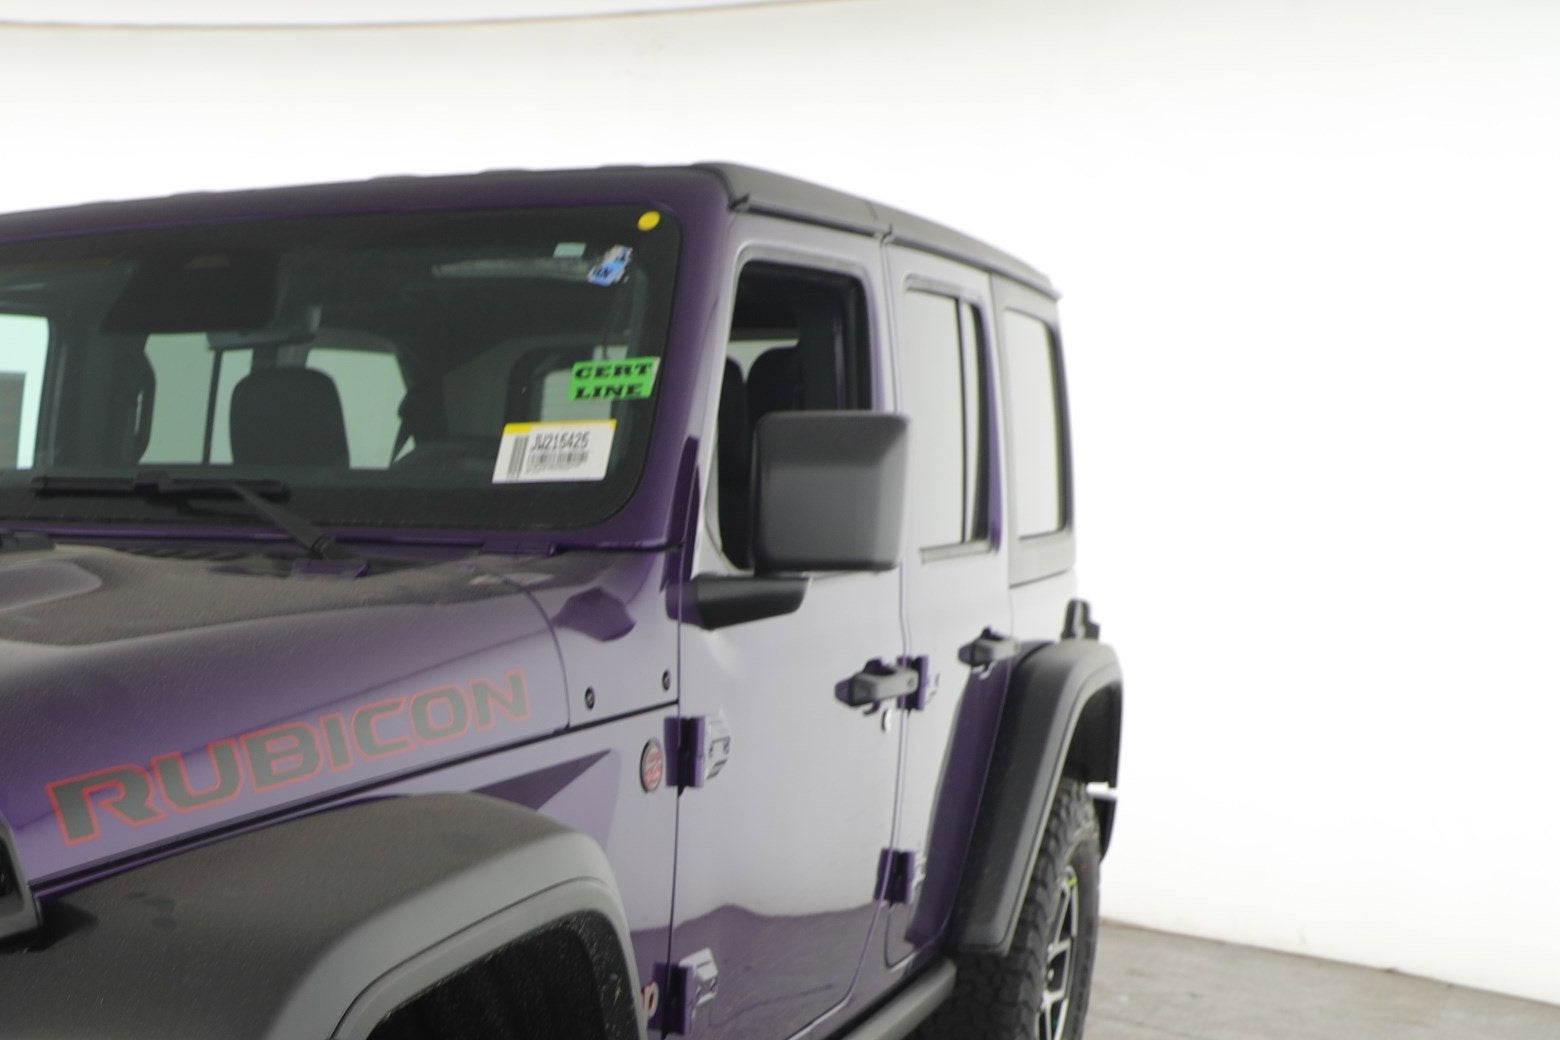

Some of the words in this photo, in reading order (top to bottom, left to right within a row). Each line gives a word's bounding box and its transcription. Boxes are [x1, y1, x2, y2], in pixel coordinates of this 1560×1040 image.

[574, 362, 652, 379] CERT
[575, 383, 643, 399] LINE
[45, 668, 532, 846] RUBICON
